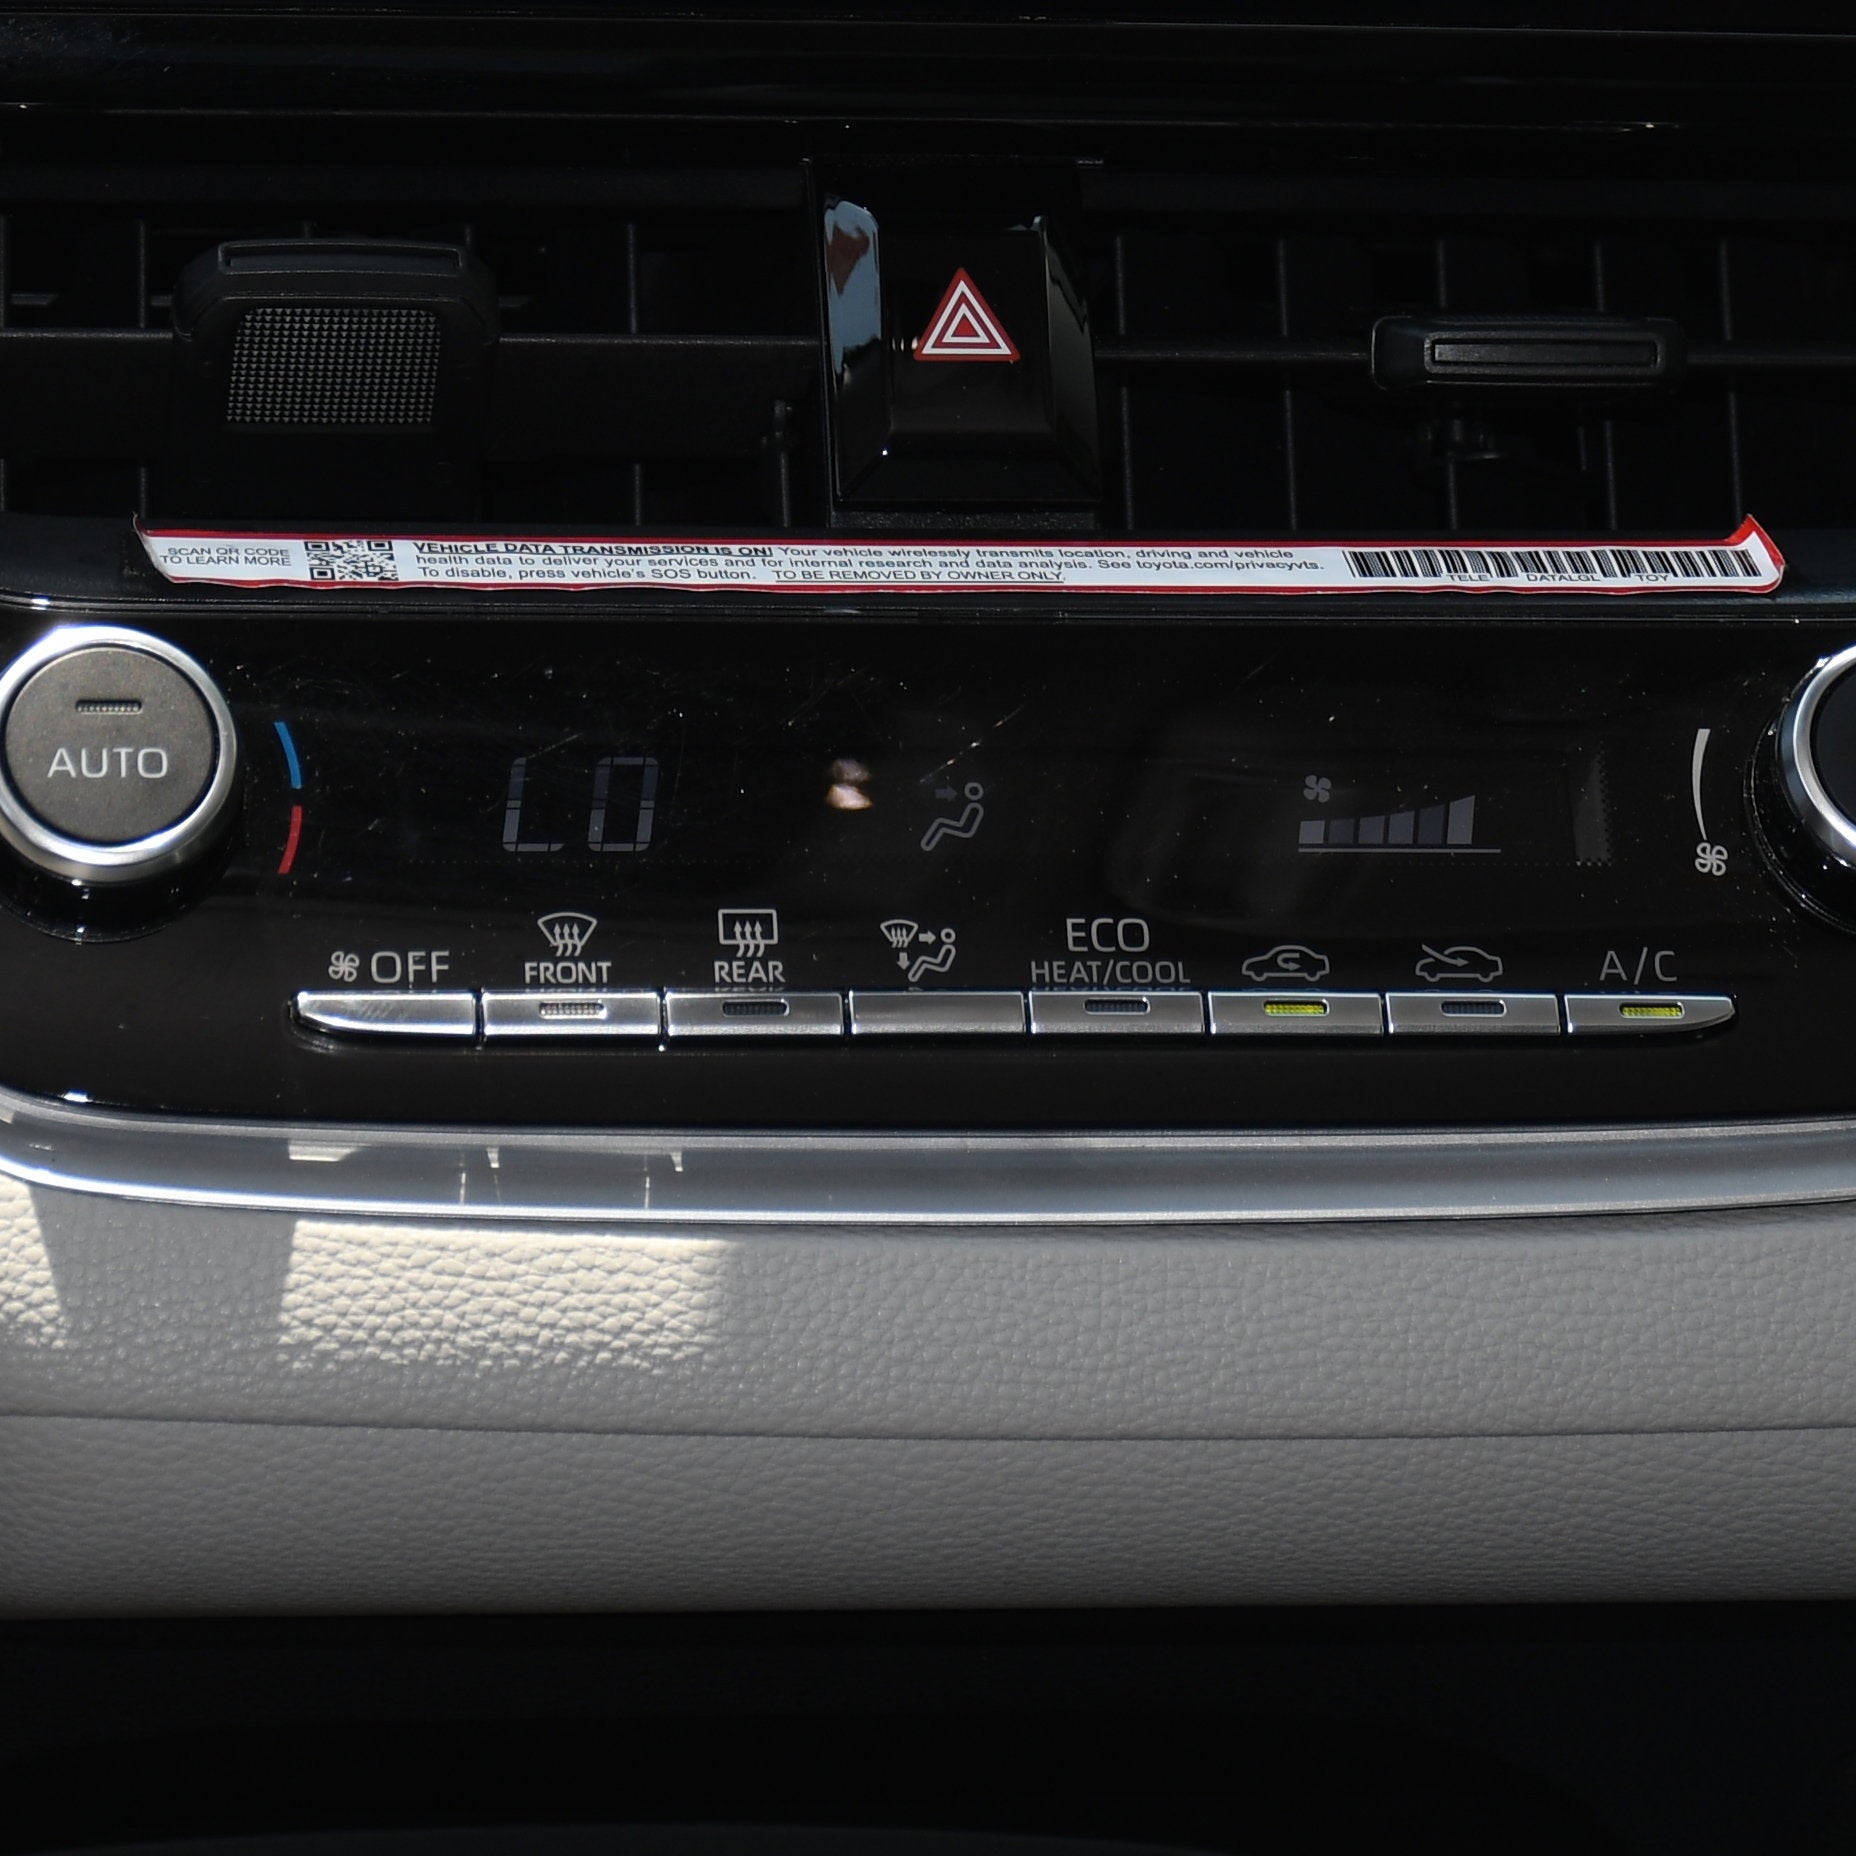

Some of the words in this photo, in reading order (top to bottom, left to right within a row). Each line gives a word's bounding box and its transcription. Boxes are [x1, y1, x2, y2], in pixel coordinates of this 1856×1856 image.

[161, 555, 182, 564] TO
[187, 555, 240, 565] LEARN
[244, 556, 291, 566] MORE
[167, 547, 211, 556] SCAN
[216, 547, 240, 556] QR
[244, 548, 290, 557] CODE
[413, 542, 497, 553] VEHICLE
[504, 543, 557, 554] DATA
[562, 545, 707, 555] TRANSMISSION
[715, 546, 732, 555] IS
[738, 546, 773, 556] ON!
[778, 547, 817, 557] Your
[823, 547, 883, 557] vehicle
[888, 548, 971, 559] wirelessly
[976, 548, 1054, 558] transmits
[1059, 548, 1131, 559] location,
[1136, 549, 1192, 560] driving
[1198, 549, 1228, 559] and
[1234, 549, 1294, 559] vehicle
[416, 555, 469, 565] health
[474, 555, 513, 566] data
[519, 556, 536, 566] to
[542, 555, 598, 566] deliver
[604, 557, 642, 568] your
[648, 557, 718, 567] services
[724, 558, 756, 567] and
[761, 558, 784, 567] for
[790, 558, 853, 568] internal
[858, 558, 932, 568] research
[938, 559, 969, 569] and
[975, 559, 1013, 569] data
[1019, 559, 1092, 571] analysis.
[1098, 560, 1131, 569] See
[1136, 560, 1325, 571] toyota.com/privacyvts.
[418, 566, 439, 577] To
[445, 567, 513, 579] disable,
[519, 569, 566, 580] press
[570, 568, 645, 579] vehicle's
[651, 569, 691, 579] SOS
[697, 568, 756, 580] button.
[772, 570, 797, 580] TO
[801, 570, 825, 580] BE
[829, 570, 916, 580] REMOVED
[920, 571, 942, 580] BY
[947, 571, 1013, 580] OWNER
[1018, 571, 1066, 581] ONLY.
[1446, 574, 1489, 582] TELE
[1526, 574, 1601, 582] DATALGL
[1635, 574, 1670, 582] TOY
[47, 748, 169, 780] AUTO
[502, 756, 659, 853] LO
[1066, 918, 1150, 952] ECO
[370, 950, 451, 985] OFF
[524, 961, 611, 985] FRONT
[715, 961, 785, 984] REAR
[1031, 960, 1191, 984] HEAT/COOL
[1600, 947, 1676, 984] A/C
